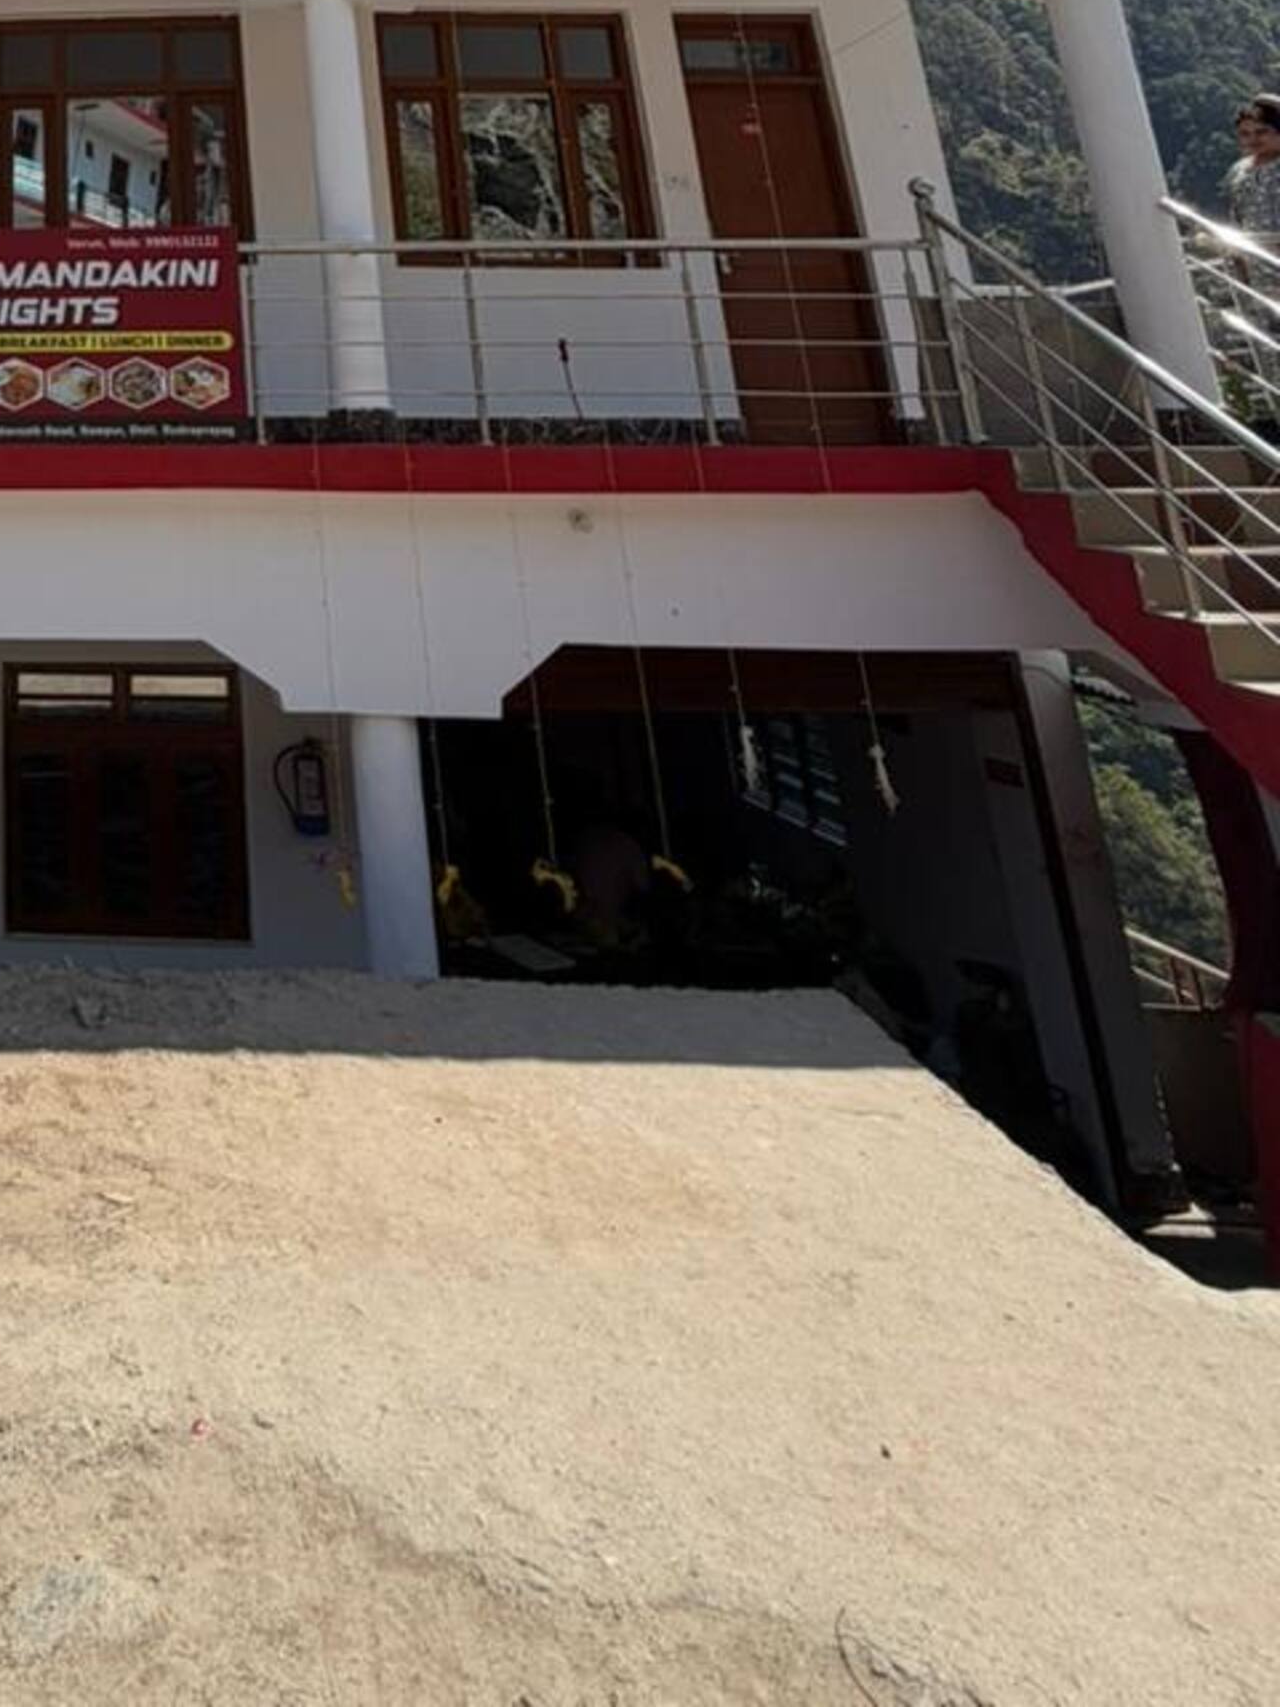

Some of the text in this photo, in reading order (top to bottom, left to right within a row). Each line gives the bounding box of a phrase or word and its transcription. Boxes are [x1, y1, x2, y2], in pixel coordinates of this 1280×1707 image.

[0, 334, 87, 349] BREAKFAST
[101, 334, 154, 349] LUNCH
[166, 334, 223, 349] DINNER
